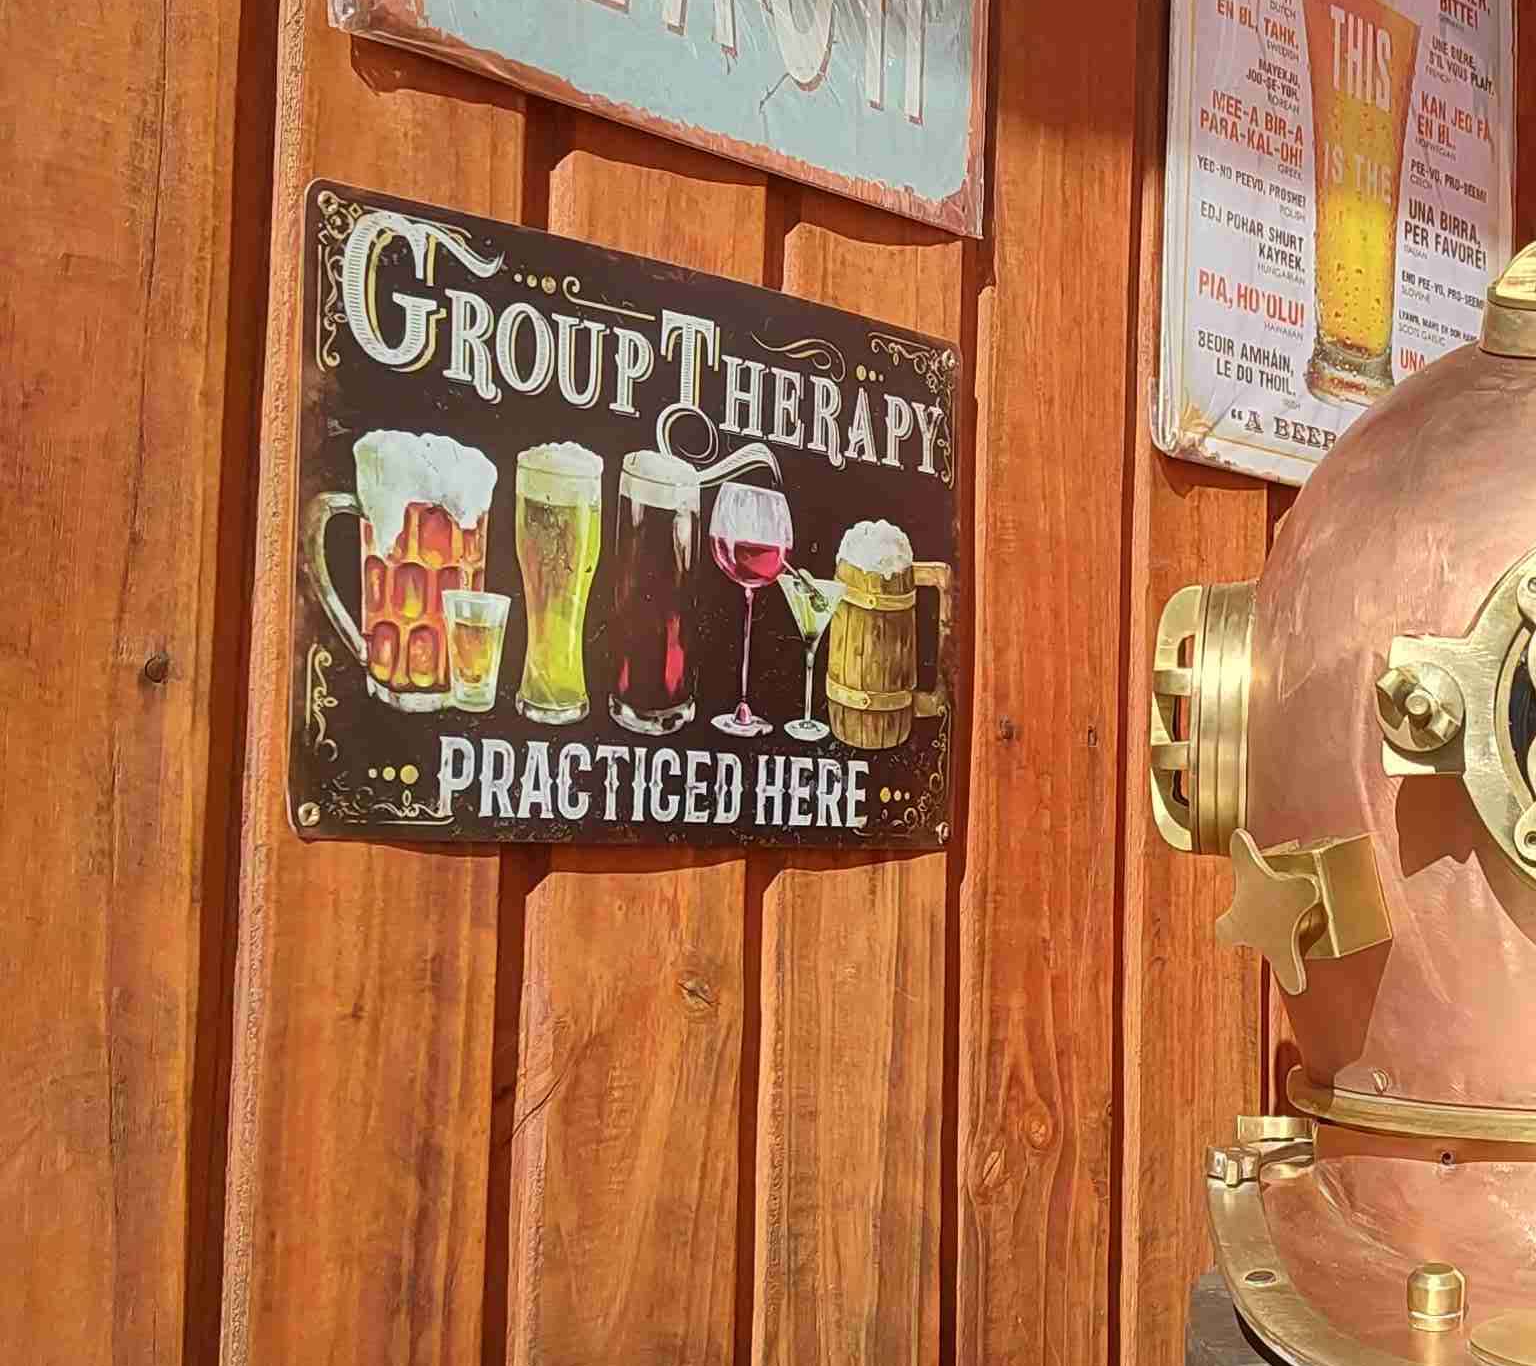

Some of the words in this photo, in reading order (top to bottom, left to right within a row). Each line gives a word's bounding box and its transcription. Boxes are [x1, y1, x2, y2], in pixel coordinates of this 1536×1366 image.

[1330, 4, 1392, 113] THIS
[1212, 90, 1259, 127] MEE-A
[1265, 112, 1303, 147] BIR-A
[1421, 91, 1446, 122] KAN
[1201, 110, 1303, 169] PARA-KAL-OH!
[1197, 154, 1232, 180] YED-NO
[1235, 170, 1266, 196] PEEVO,
[1325, 142, 1345, 186] IS
[1355, 155, 1392, 206] THE
[1200, 201, 1222, 223] EDJ
[1226, 211, 1263, 236] POHAR
[1269, 226, 1304, 252] SHURT
[1404, 221, 1429, 248] PER
[1409, 198, 1434, 227] UNA
[1440, 210, 1481, 248] BIRRA,
[1259, 243, 1305, 273] KAYREK.
[1198, 269, 1233, 310] PIA,
[342, 209, 656, 419] GROUP
[658, 309, 945, 485] THERAPY
[1198, 330, 1234, 357] BEOIR
[1240, 342, 1294, 377] AMHÁIN,
[1216, 357, 1231, 378] LE
[1236, 363, 1253, 384] DO
[1259, 370, 1296, 396] THOIL.
[437, 736, 742, 824] PRACTICED
[755, 754, 868, 828] HERE
